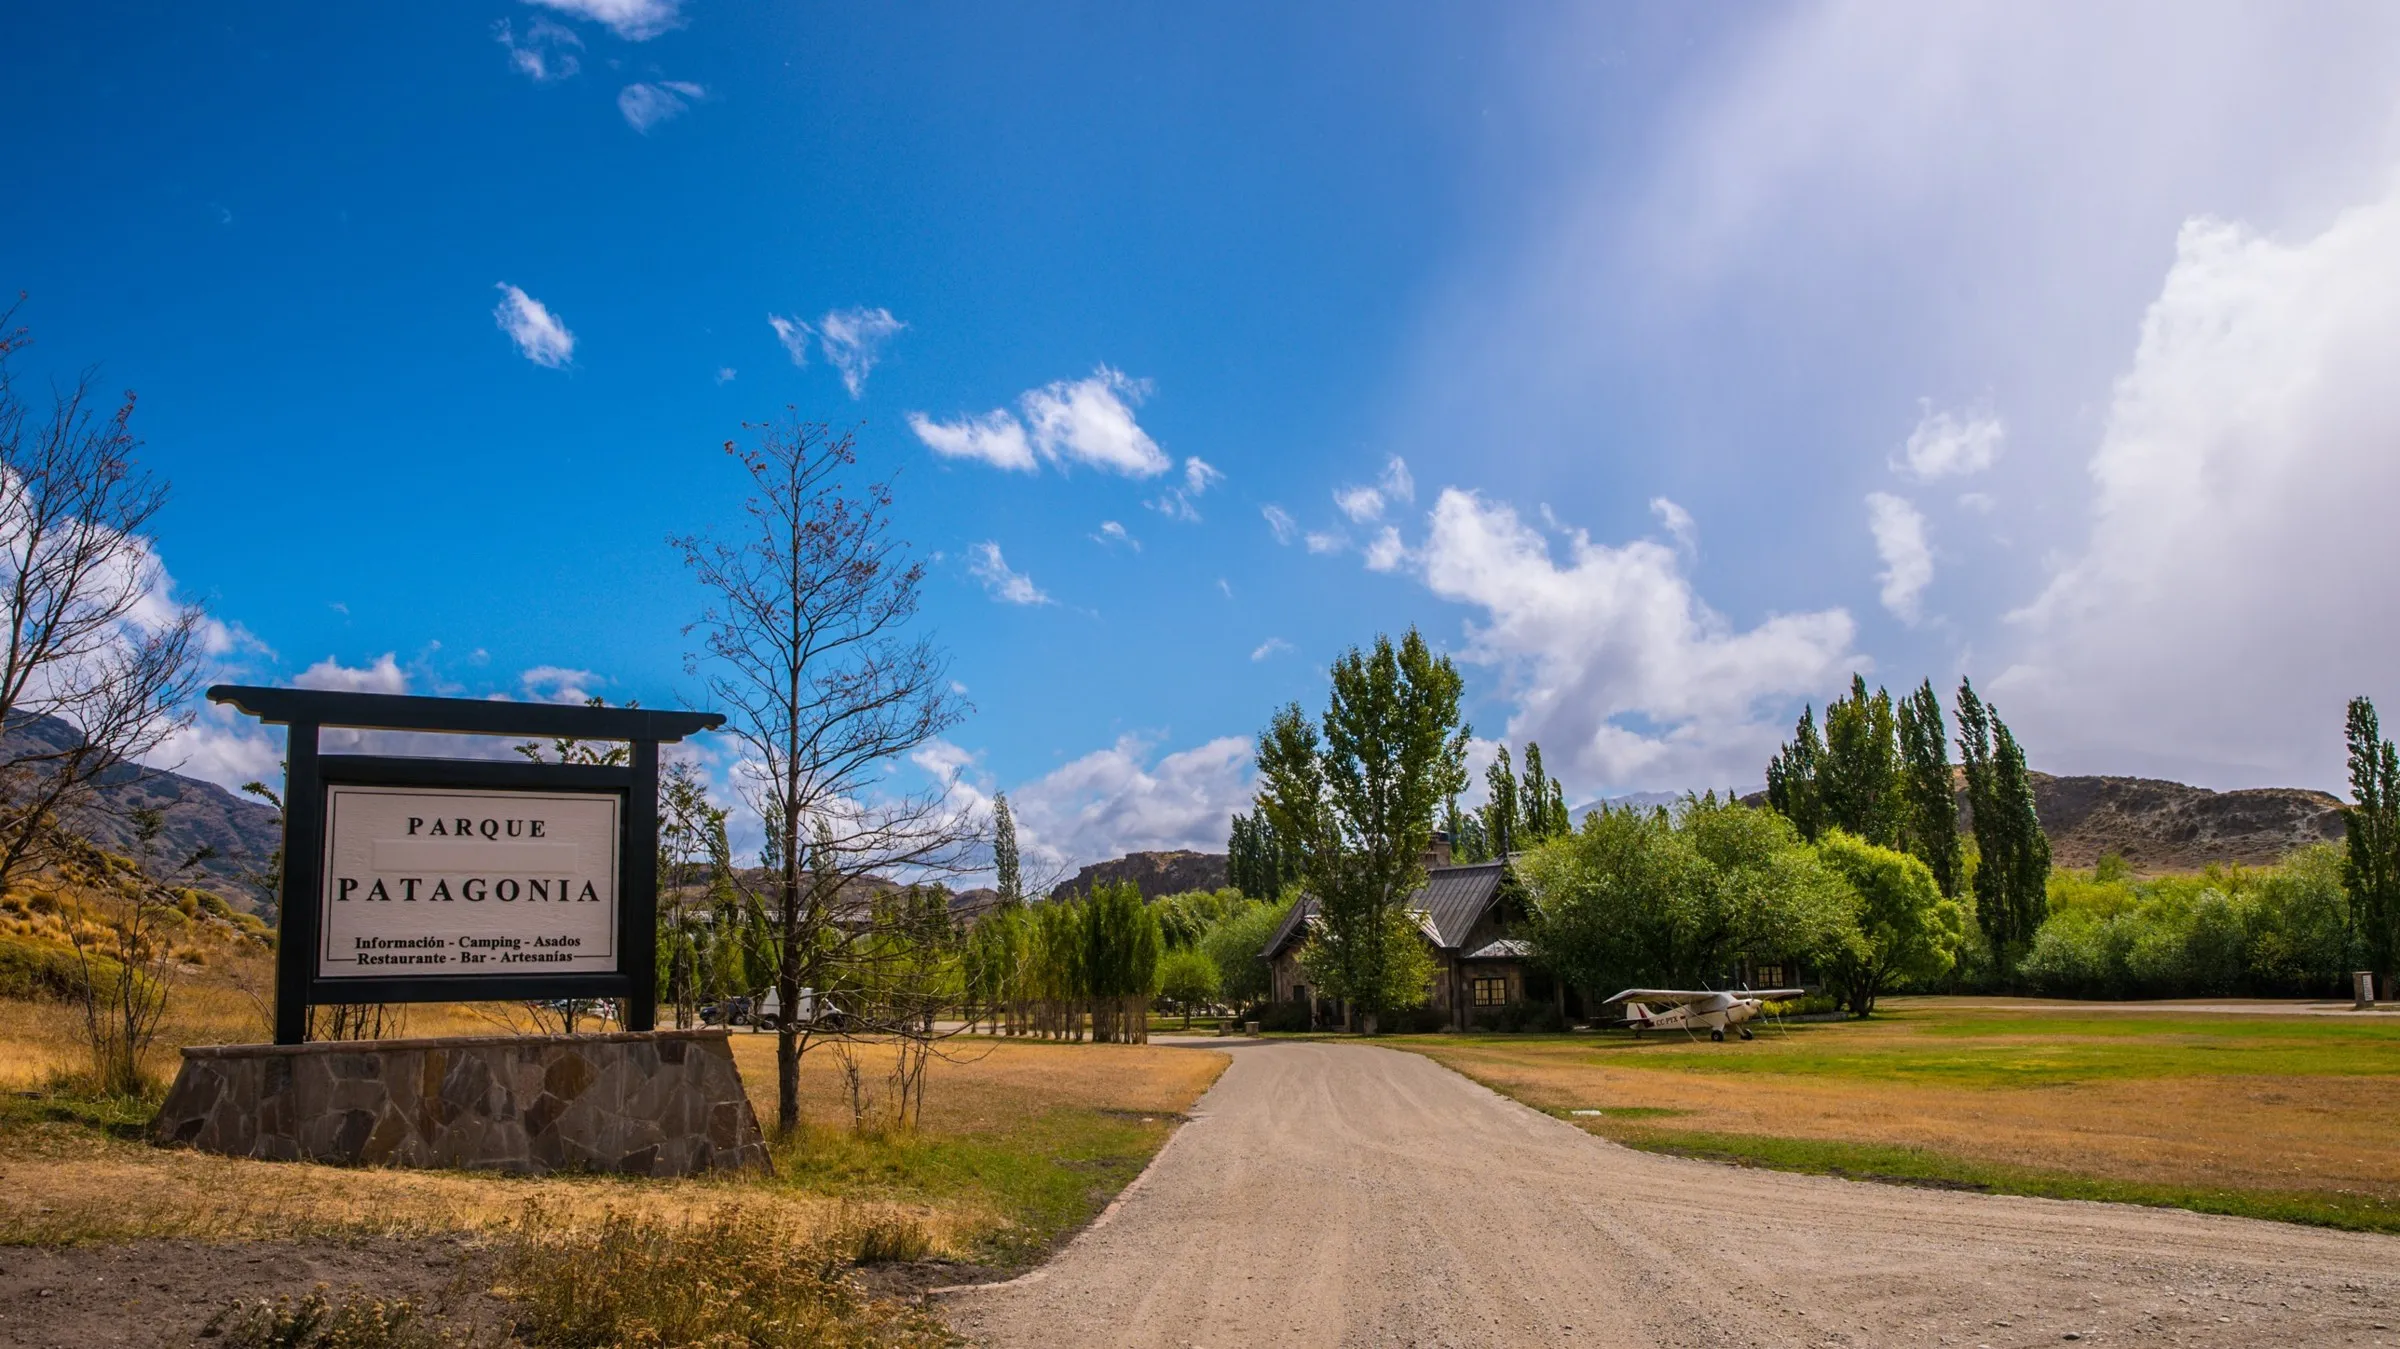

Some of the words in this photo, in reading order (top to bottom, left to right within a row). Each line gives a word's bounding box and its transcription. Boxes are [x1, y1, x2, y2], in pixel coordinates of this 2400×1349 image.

[407, 817, 546, 840] PARQUE
[337, 878, 600, 901] PATAGONIA
[355, 937, 445, 949] Información
[458, 936, 521, 950] Camping
[533, 935, 581, 947] Asados
[357, 953, 446, 965] Restaurante
[460, 952, 487, 963] Bar
[500, 951, 573, 963] Artesanías
